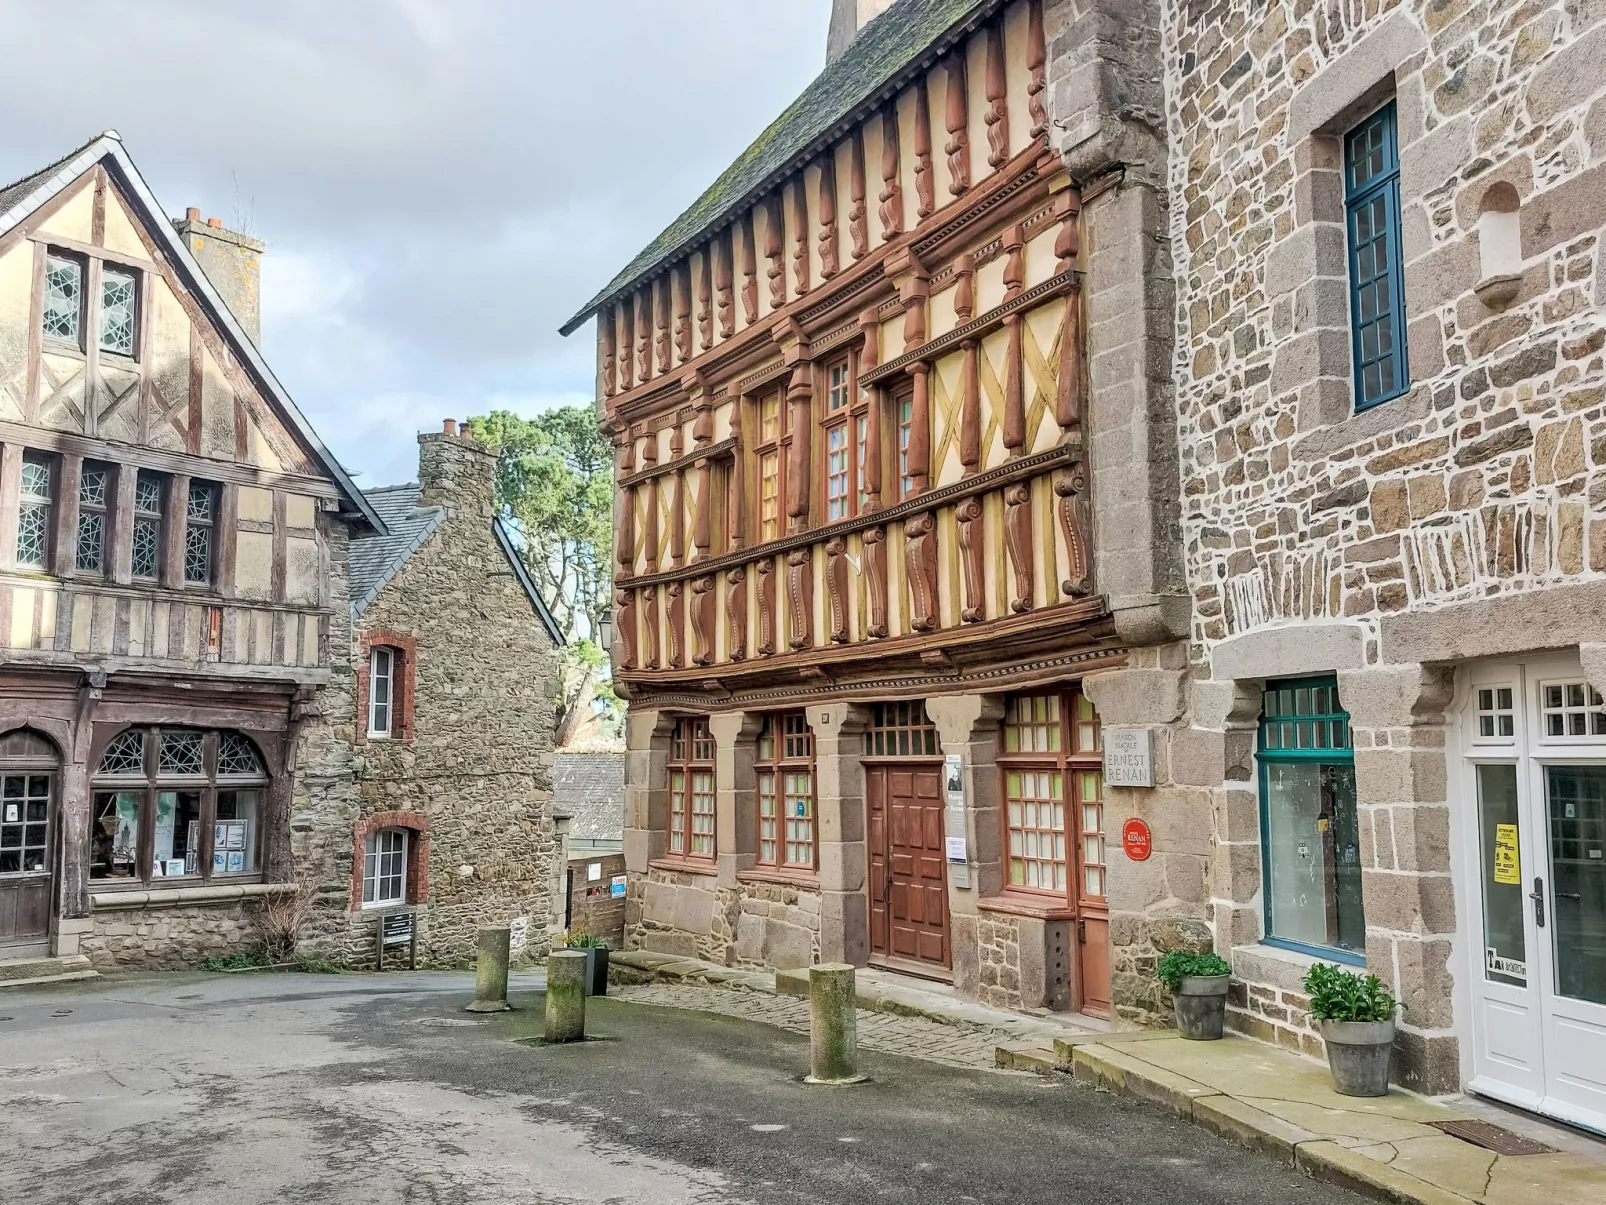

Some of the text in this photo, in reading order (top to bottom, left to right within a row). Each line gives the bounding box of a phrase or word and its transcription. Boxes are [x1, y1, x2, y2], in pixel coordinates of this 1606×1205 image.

[1108, 754, 1145, 766] ERNEST
[1108, 768, 1147, 781] RENAN
[1127, 834, 1145, 842] RENAN
